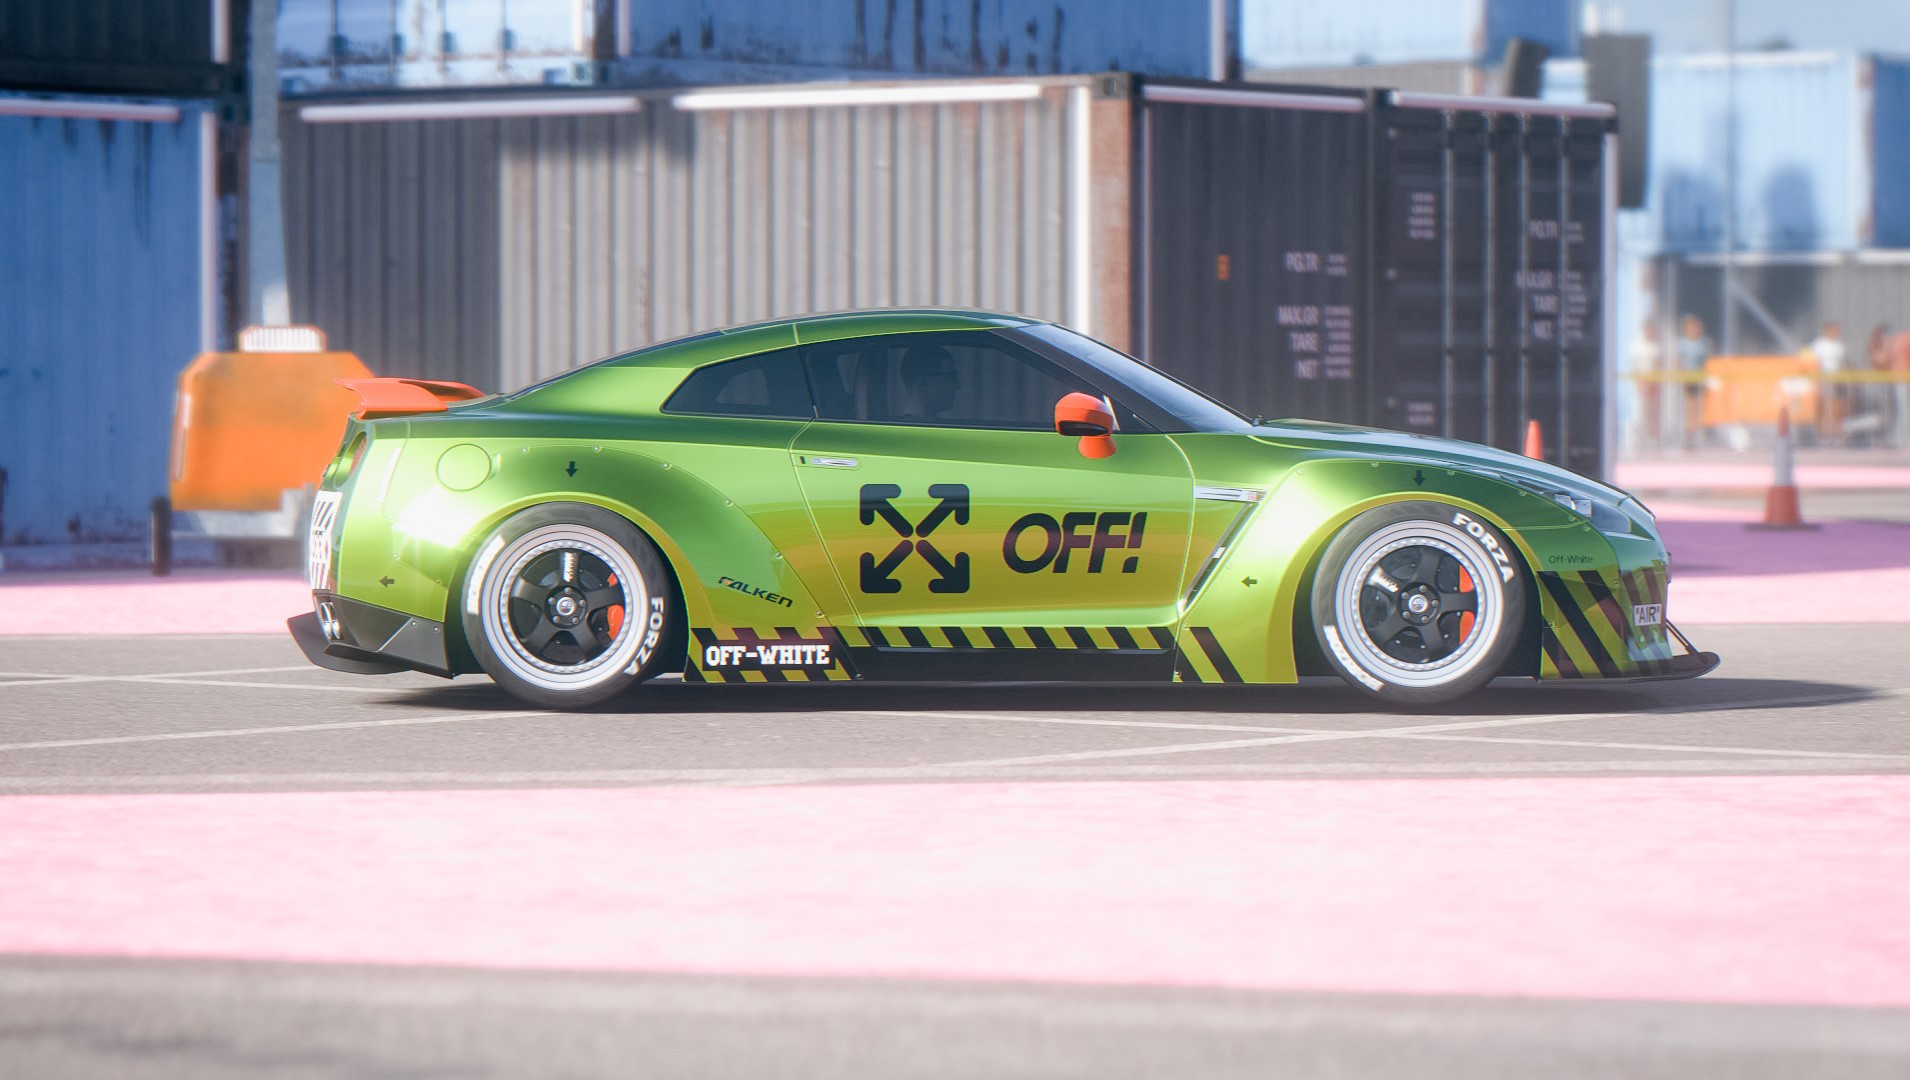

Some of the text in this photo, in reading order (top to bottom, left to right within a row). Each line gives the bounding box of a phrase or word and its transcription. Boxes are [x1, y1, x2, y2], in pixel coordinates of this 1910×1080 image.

[1289, 332, 1319, 352] TARE
[1295, 359, 1319, 379] NET
[1002, 511, 1148, 574] OFF!
[1452, 512, 1515, 584] FORZA
[1548, 554, 1594, 564] Off-White
[718, 576, 794, 608] FALKEN
[1635, 606, 1661, 624] "AIR"
[623, 596, 664, 676] FORZA
[705, 644, 831, 667] OFF-WHITE
